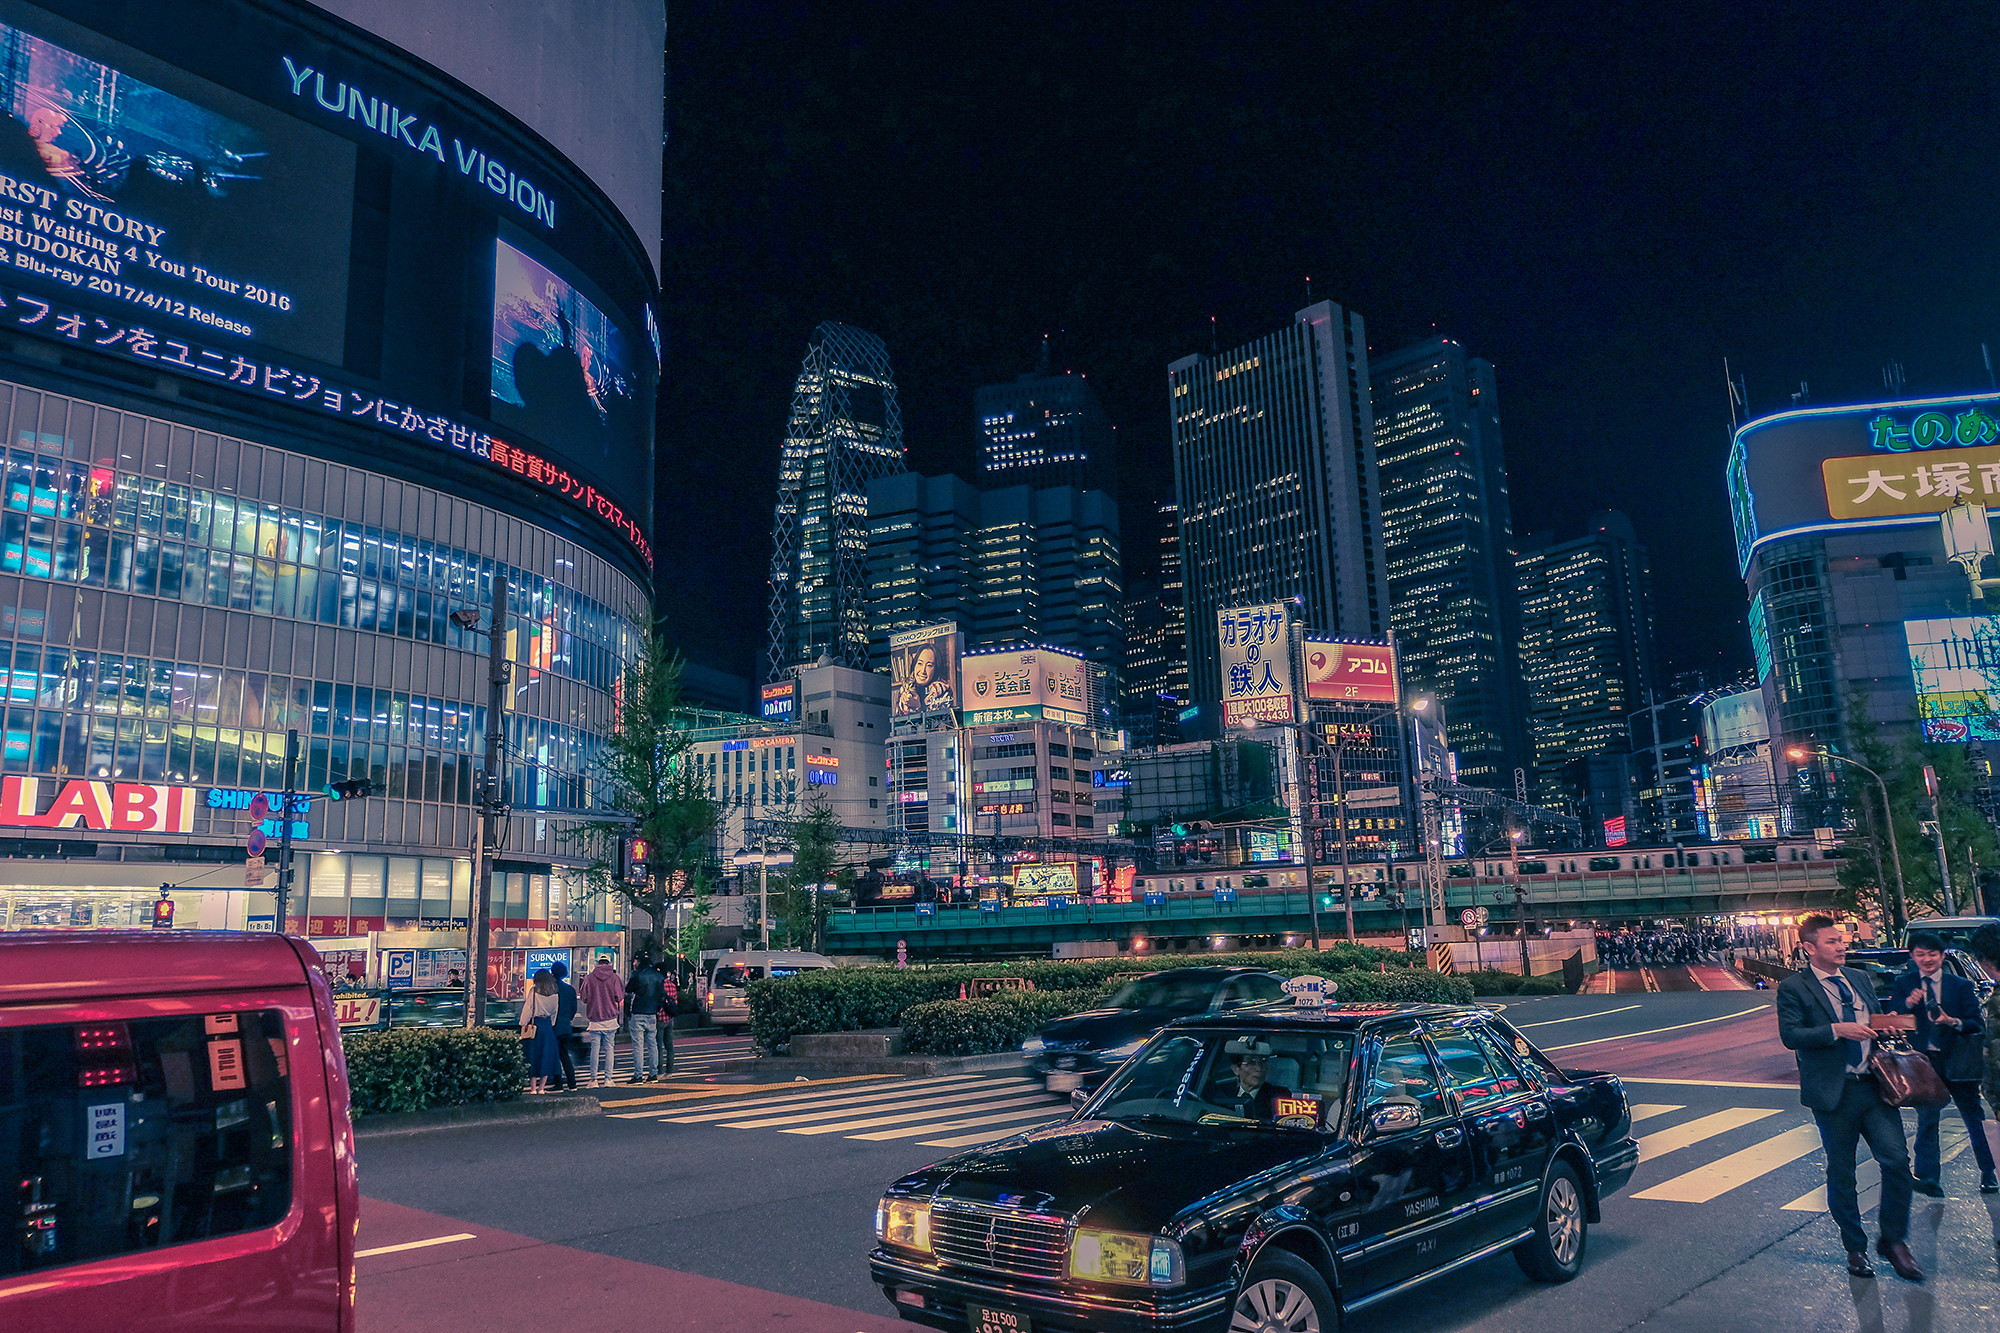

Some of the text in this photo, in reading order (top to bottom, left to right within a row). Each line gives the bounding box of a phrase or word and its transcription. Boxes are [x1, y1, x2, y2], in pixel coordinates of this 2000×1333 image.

[282, 56, 556, 229] YUNIKA VISION
[65, 199, 166, 248] STORY
[0, 223, 121, 276] BUDOKAN
[32, 212, 119, 259] Waiting
[124, 246, 138, 262] 4
[145, 250, 186, 278] You
[192, 265, 240, 295] Tour
[244, 284, 291, 312] 2016
[15, 254, 84, 286] Blu-ray
[88, 275, 185, 315] 2017/4/12
[189, 305, 252, 336] Release
[1870, 408, 2000, 452] たのめ
[1220, 605, 1284, 649] カラオケ
[1246, 641, 1261, 665] の
[994, 668, 1031, 681] シェーン
[1347, 657, 1388, 675] アコム
[995, 679, 1031, 694] 英会話
[1227, 660, 1283, 698] 鉄人
[762, 684, 793, 699] ビックカメラ
[1344, 686, 1358, 697] 2F
[764, 700, 792, 716] ODAKYU
[972, 709, 1014, 723] 新宿本校
[1227, 710, 1290, 725] 03-45-6430
[753, 737, 796, 748] BIC CAMERA
[808, 770, 838, 785] ODAKYU
[0, 773, 197, 833] LABI
[208, 788, 311, 813] SHINUU
[391, 957, 403, 976] P
[530, 953, 568, 962] SUBNADE
[332, 992, 369, 1000] rohibited.
[1299, 998, 1314, 1006] 1072
[1506, 1165, 1522, 1181] 1072
[1404, 1195, 1440, 1218] YASHIMA
[1416, 1238, 1438, 1256] TAXI
